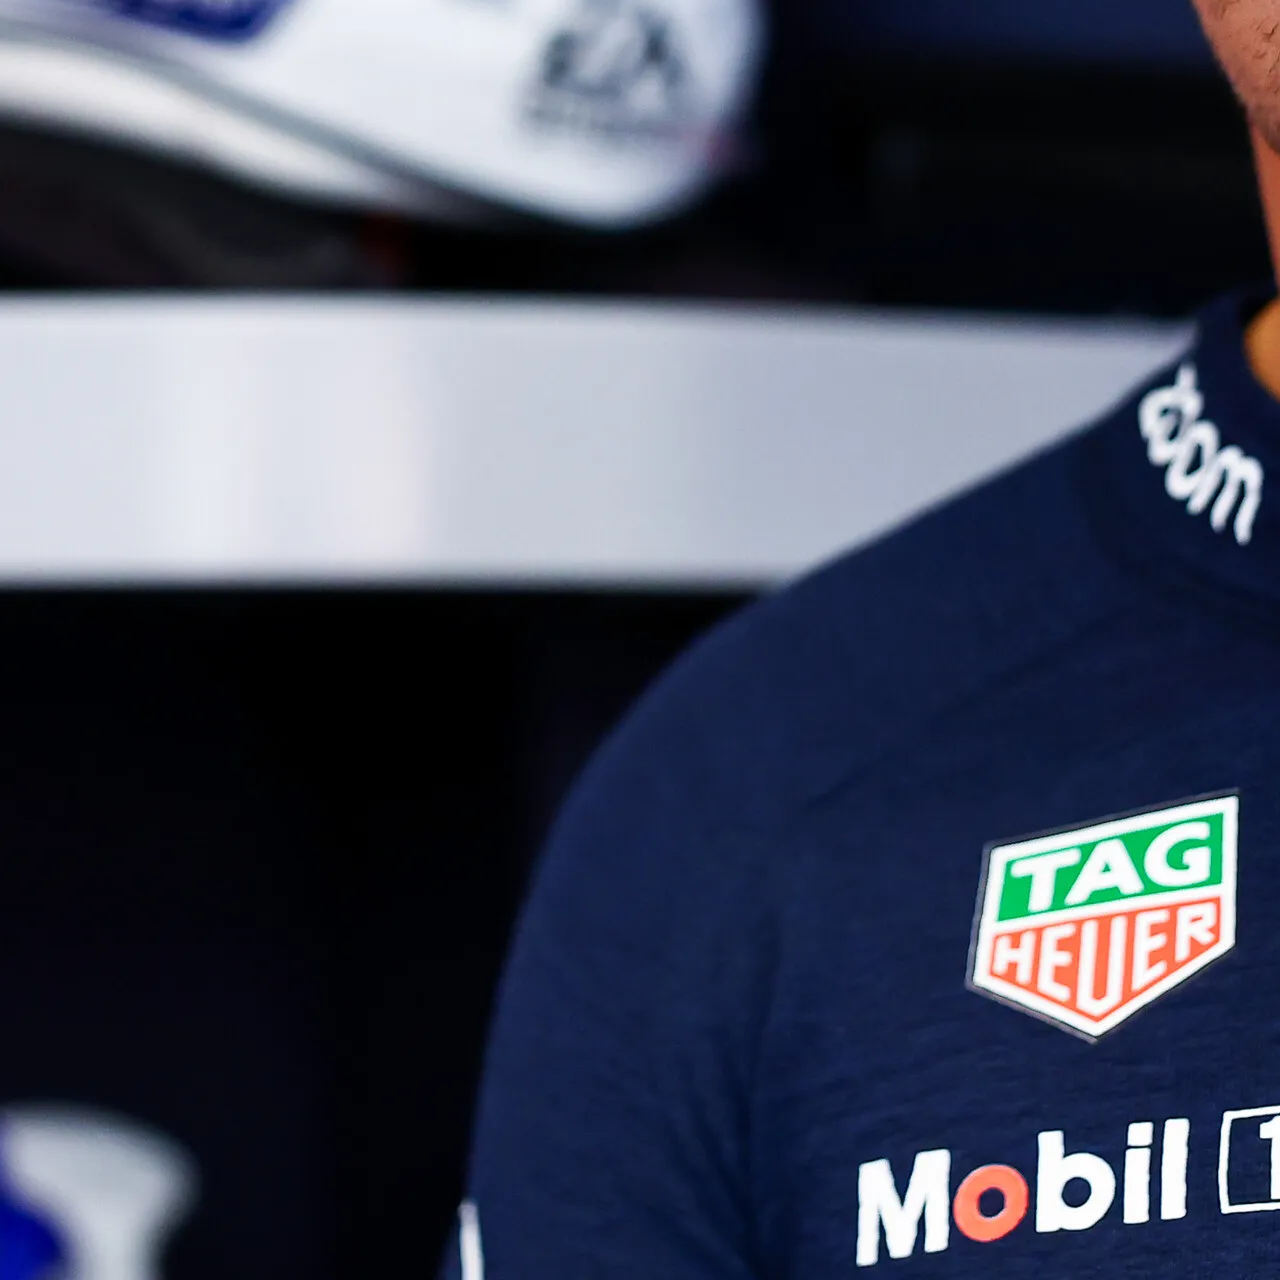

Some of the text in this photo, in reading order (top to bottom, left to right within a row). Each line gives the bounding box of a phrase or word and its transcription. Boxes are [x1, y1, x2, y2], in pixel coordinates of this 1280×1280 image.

[1010, 821, 1211, 913] TAG
[991, 902, 1217, 1017] HEUER
[856, 1117, 1190, 1267] Mobil
